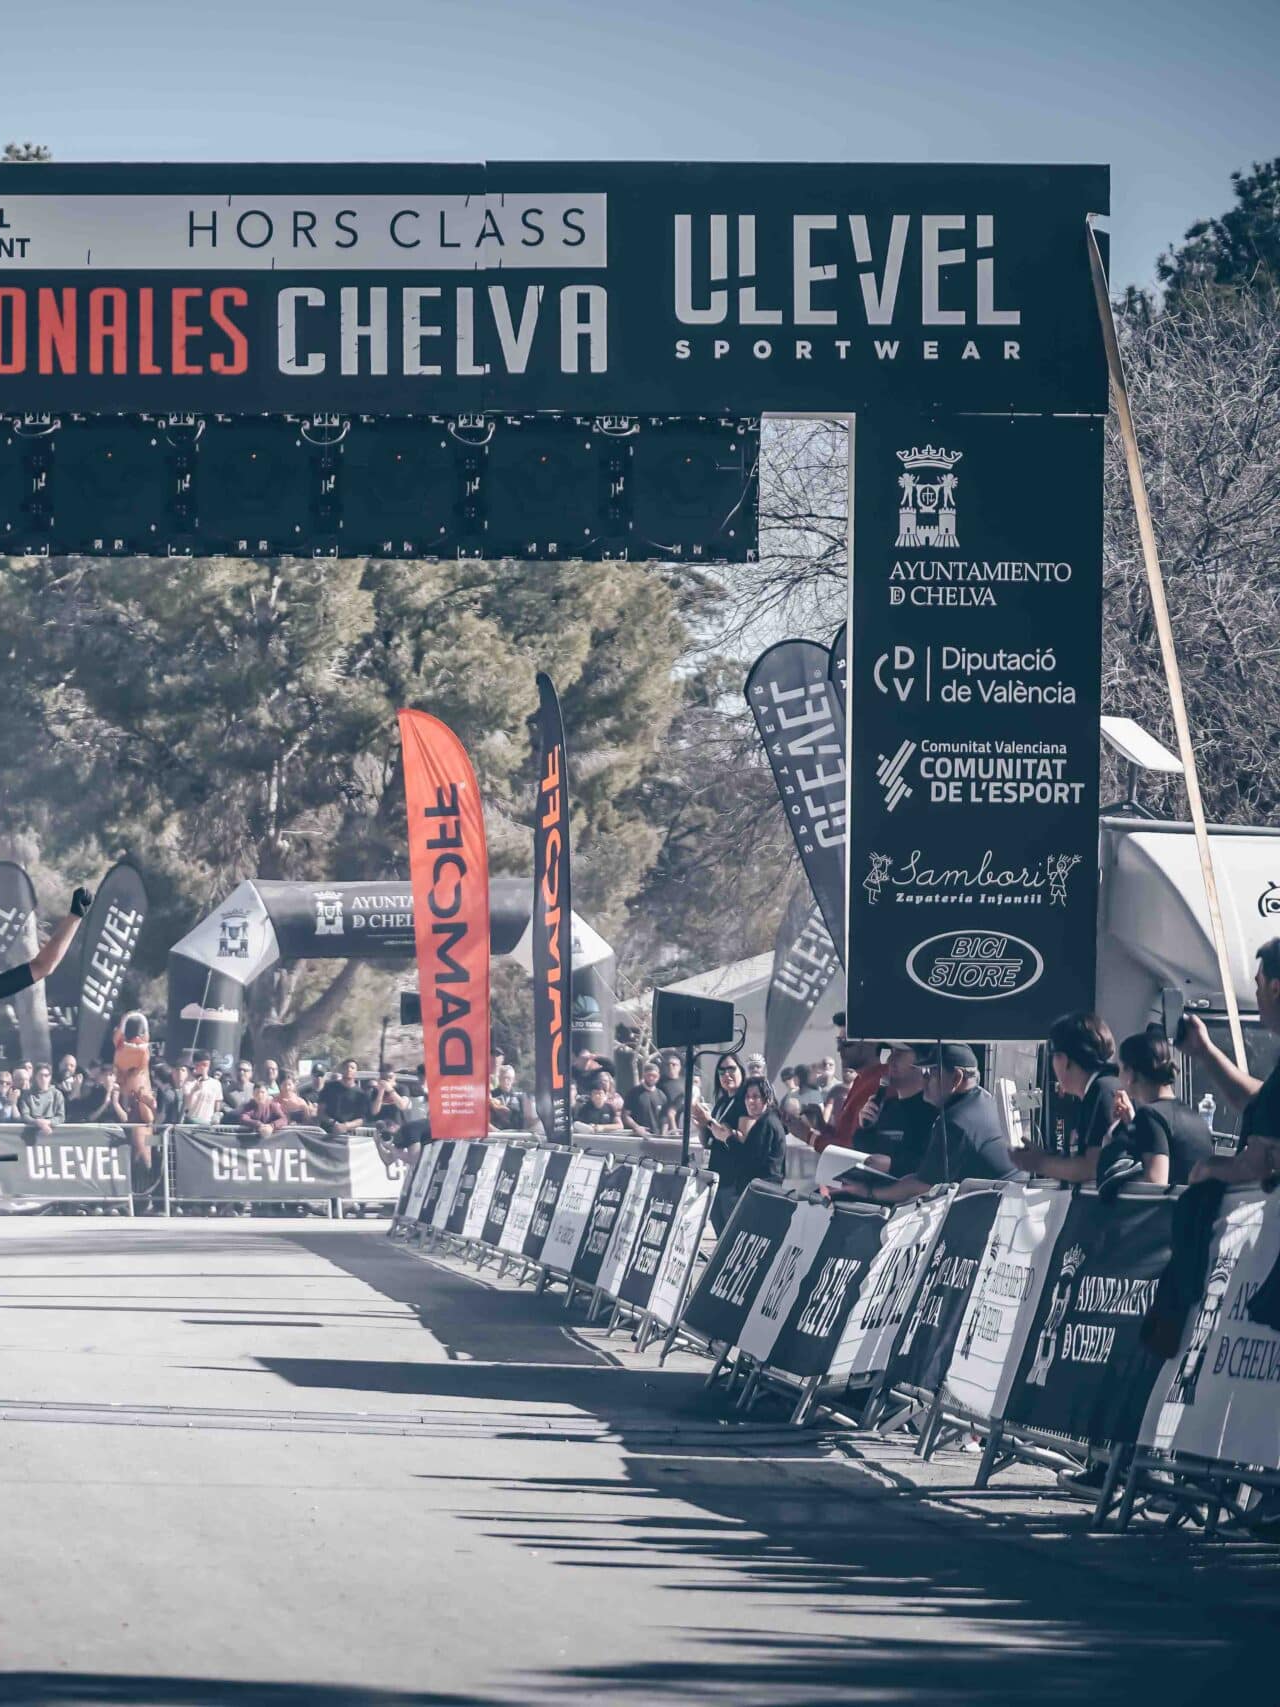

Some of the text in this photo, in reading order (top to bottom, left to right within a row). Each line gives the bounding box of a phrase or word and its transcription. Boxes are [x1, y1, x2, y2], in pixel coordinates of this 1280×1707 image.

[189, 207, 587, 249] HORS CLASS
[675, 214, 1021, 326] ULEVEL
[277, 284, 608, 376] CHELVA
[675, 339, 1020, 360] SPORTWEAR
[888, 560, 1072, 583] AYUNTAMIENTO
[910, 585, 997, 606] CHELVA
[942, 646, 1057, 676] Diputació
[940, 679, 1076, 705] de València
[921, 739, 1068, 755] Comunitat Valenciana
[920, 756, 1067, 780] COMUNITAT
[930, 781, 1085, 804] DE L'ESPORT
[892, 849, 1047, 888] Sambori
[351, 895, 414, 909] AYUNTA
[979, 892, 1042, 905] Infantil
[369, 913, 415, 929] CHEL
[950, 936, 1008, 959] BICI
[927, 963, 1022, 987] STORE
[27, 1145, 126, 1181] ULEVEL
[213, 1146, 316, 1184] ULEVEL
[1074, 1275, 1160, 1316] AYUNTAMIENT
